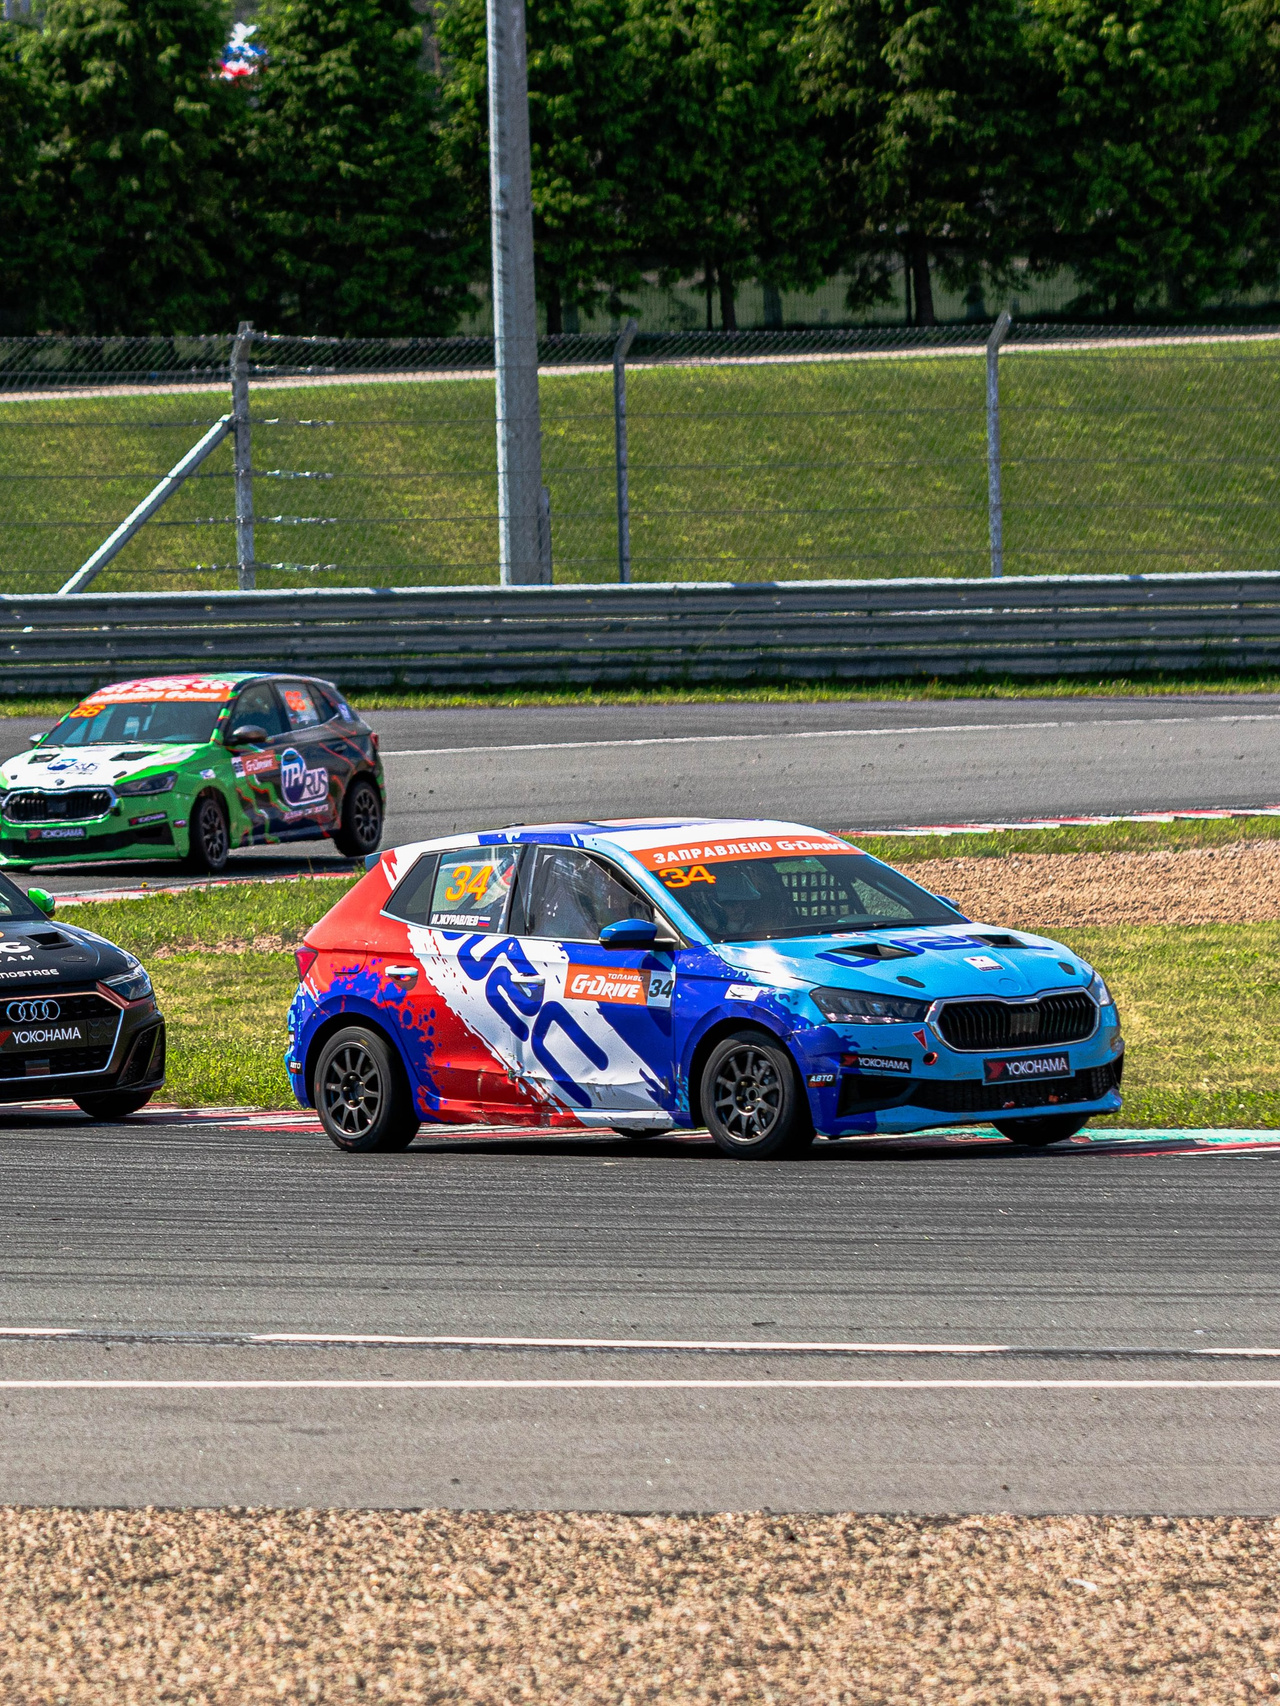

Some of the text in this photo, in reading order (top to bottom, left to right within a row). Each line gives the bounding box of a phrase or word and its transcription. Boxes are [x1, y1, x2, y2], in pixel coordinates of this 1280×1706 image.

[70, 705, 106, 718] 66
[653, 841, 773, 864] ЗАПРАВЛЕНО
[445, 865, 494, 901] 34
[659, 865, 716, 888] 34
[649, 978, 675, 998] 34
[12, 1027, 81, 1044] YOKOHAMA
[857, 1057, 910, 1071] YOKOHAMA
[1005, 1057, 1068, 1076] YOKOHAMA
